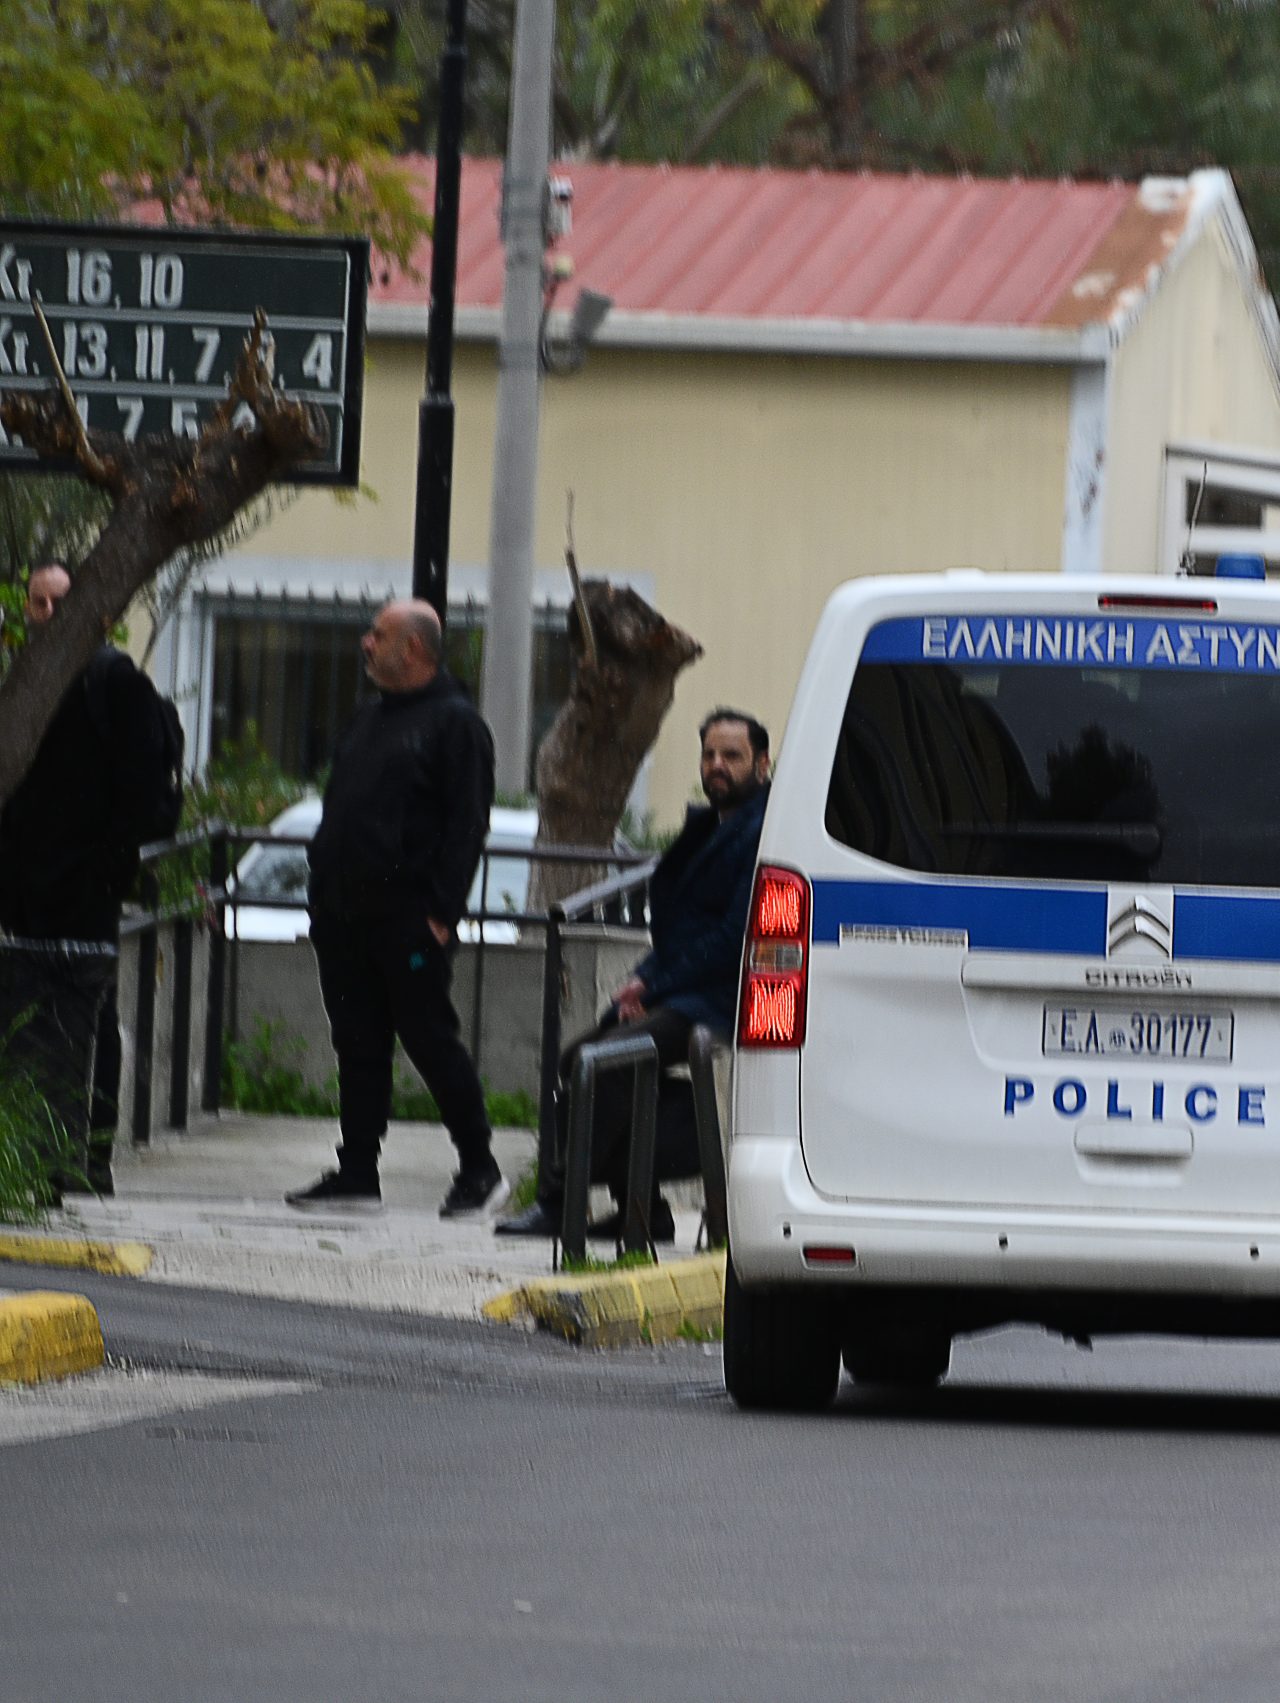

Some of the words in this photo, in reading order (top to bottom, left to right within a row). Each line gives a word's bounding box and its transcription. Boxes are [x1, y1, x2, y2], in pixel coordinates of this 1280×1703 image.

[66, 248, 121, 312] 16,
[140, 254, 183, 309] 10
[63, 321, 117, 382] 13,
[136, 325, 175, 385] 11,
[303, 332, 332, 388] 4
[923, 617, 1133, 663] ΕΛΛΗΝΙΚΗ
[1130, 1011, 1211, 1058] 30177
[1004, 1076, 1266, 1126] POLICE
